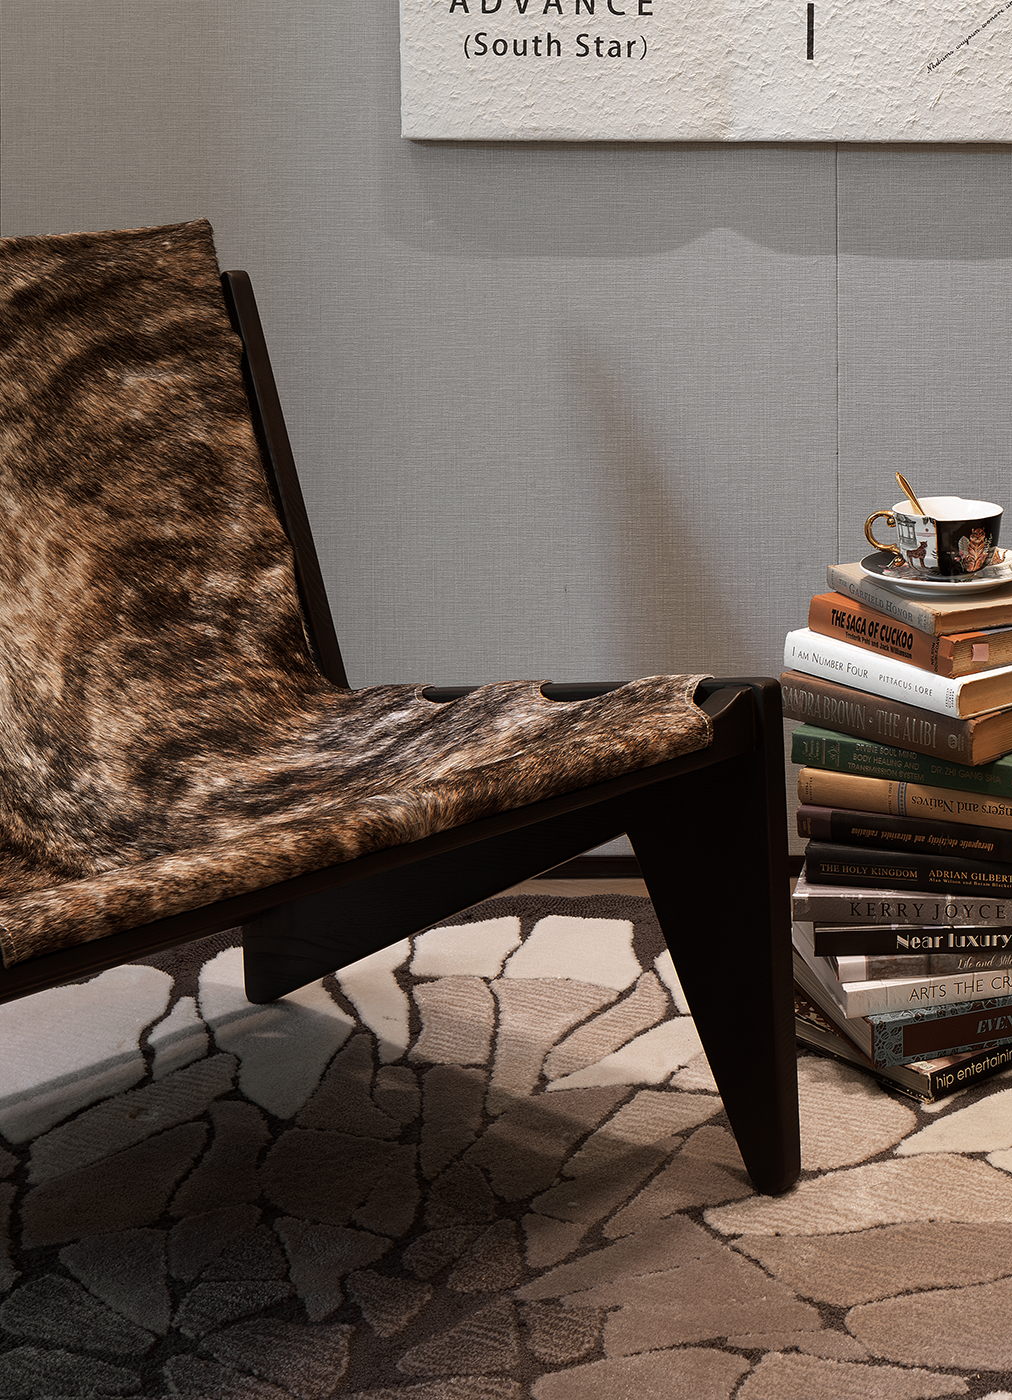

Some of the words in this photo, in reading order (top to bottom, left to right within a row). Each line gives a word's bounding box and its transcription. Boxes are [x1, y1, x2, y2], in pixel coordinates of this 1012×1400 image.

[463, 32, 562, 60] (South
[576, 33, 648, 60] Star)
[849, 583, 884, 609] GARFIELD
[885, 600, 913, 622] HONOR
[831, 608, 847, 628] THE
[845, 613, 867, 636] SAGA
[867, 620, 880, 639] OF
[880, 624, 914, 651] CUCKOO
[871, 640, 879, 648] and
[792, 646, 796, 657] I
[797, 650, 810, 661] AM
[811, 652, 845, 672] NUMBER
[846, 662, 870, 679] FOUR
[878, 674, 912, 691] PITTACUS
[914, 684, 933, 697] LORE
[781, 685, 822, 719] SANDRA
[823, 695, 866, 730] BROWN
[875, 708, 900, 739] THE
[902, 715, 938, 749] ALIBI
[852, 752, 872, 764] BODY
[872, 755, 903, 768] HEALING
[903, 761, 920, 770] AND
[856, 742, 878, 756] DIVINE
[879, 746, 898, 758] SOUL
[898, 749, 918, 761] MIND
[847, 761, 898, 778] TRANSMISSION
[898, 770, 925, 782] SYSTEM
[944, 766, 957, 778] ZHI
[958, 769, 983, 781] GANG
[984, 773, 1001, 783] SHA
[911, 795, 954, 813] Natives
[956, 799, 978, 814] and
[913, 834, 926, 844] and
[820, 863, 840, 874] THE
[842, 865, 869, 876] HOLY
[871, 868, 918, 879] KINGDOM
[928, 869, 967, 882] ADRIAN
[850, 902, 925, 918] KERRY
[932, 903, 1006, 921] JOYCE
[896, 934, 944, 950] Near
[948, 931, 1012, 949] luxury
[975, 955, 994, 968] and
[909, 984, 947, 1002] ARTS
[954, 978, 984, 995] THE
[935, 1073, 955, 1090] hip
